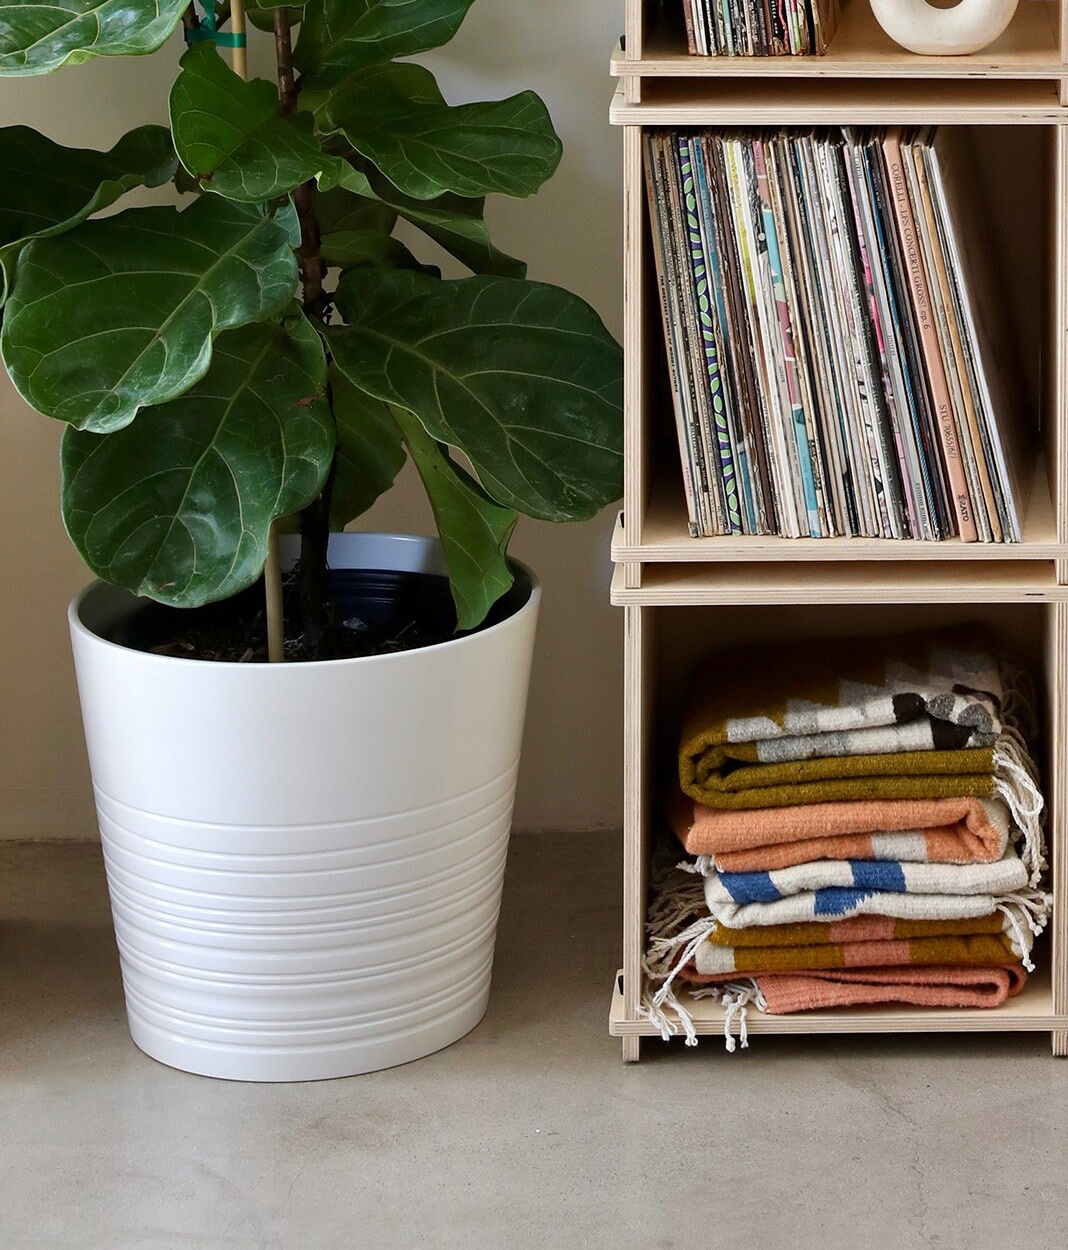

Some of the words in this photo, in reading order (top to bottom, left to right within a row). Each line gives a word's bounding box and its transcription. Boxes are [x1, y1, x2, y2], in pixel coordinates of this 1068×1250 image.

[891, 163, 905, 202] CORELLI
[903, 229, 919, 274] CONCERTI
[661, 288, 669, 315] GREATEST
[939, 405, 950, 421] STU
[685, 467, 693, 497] VANGUARD
